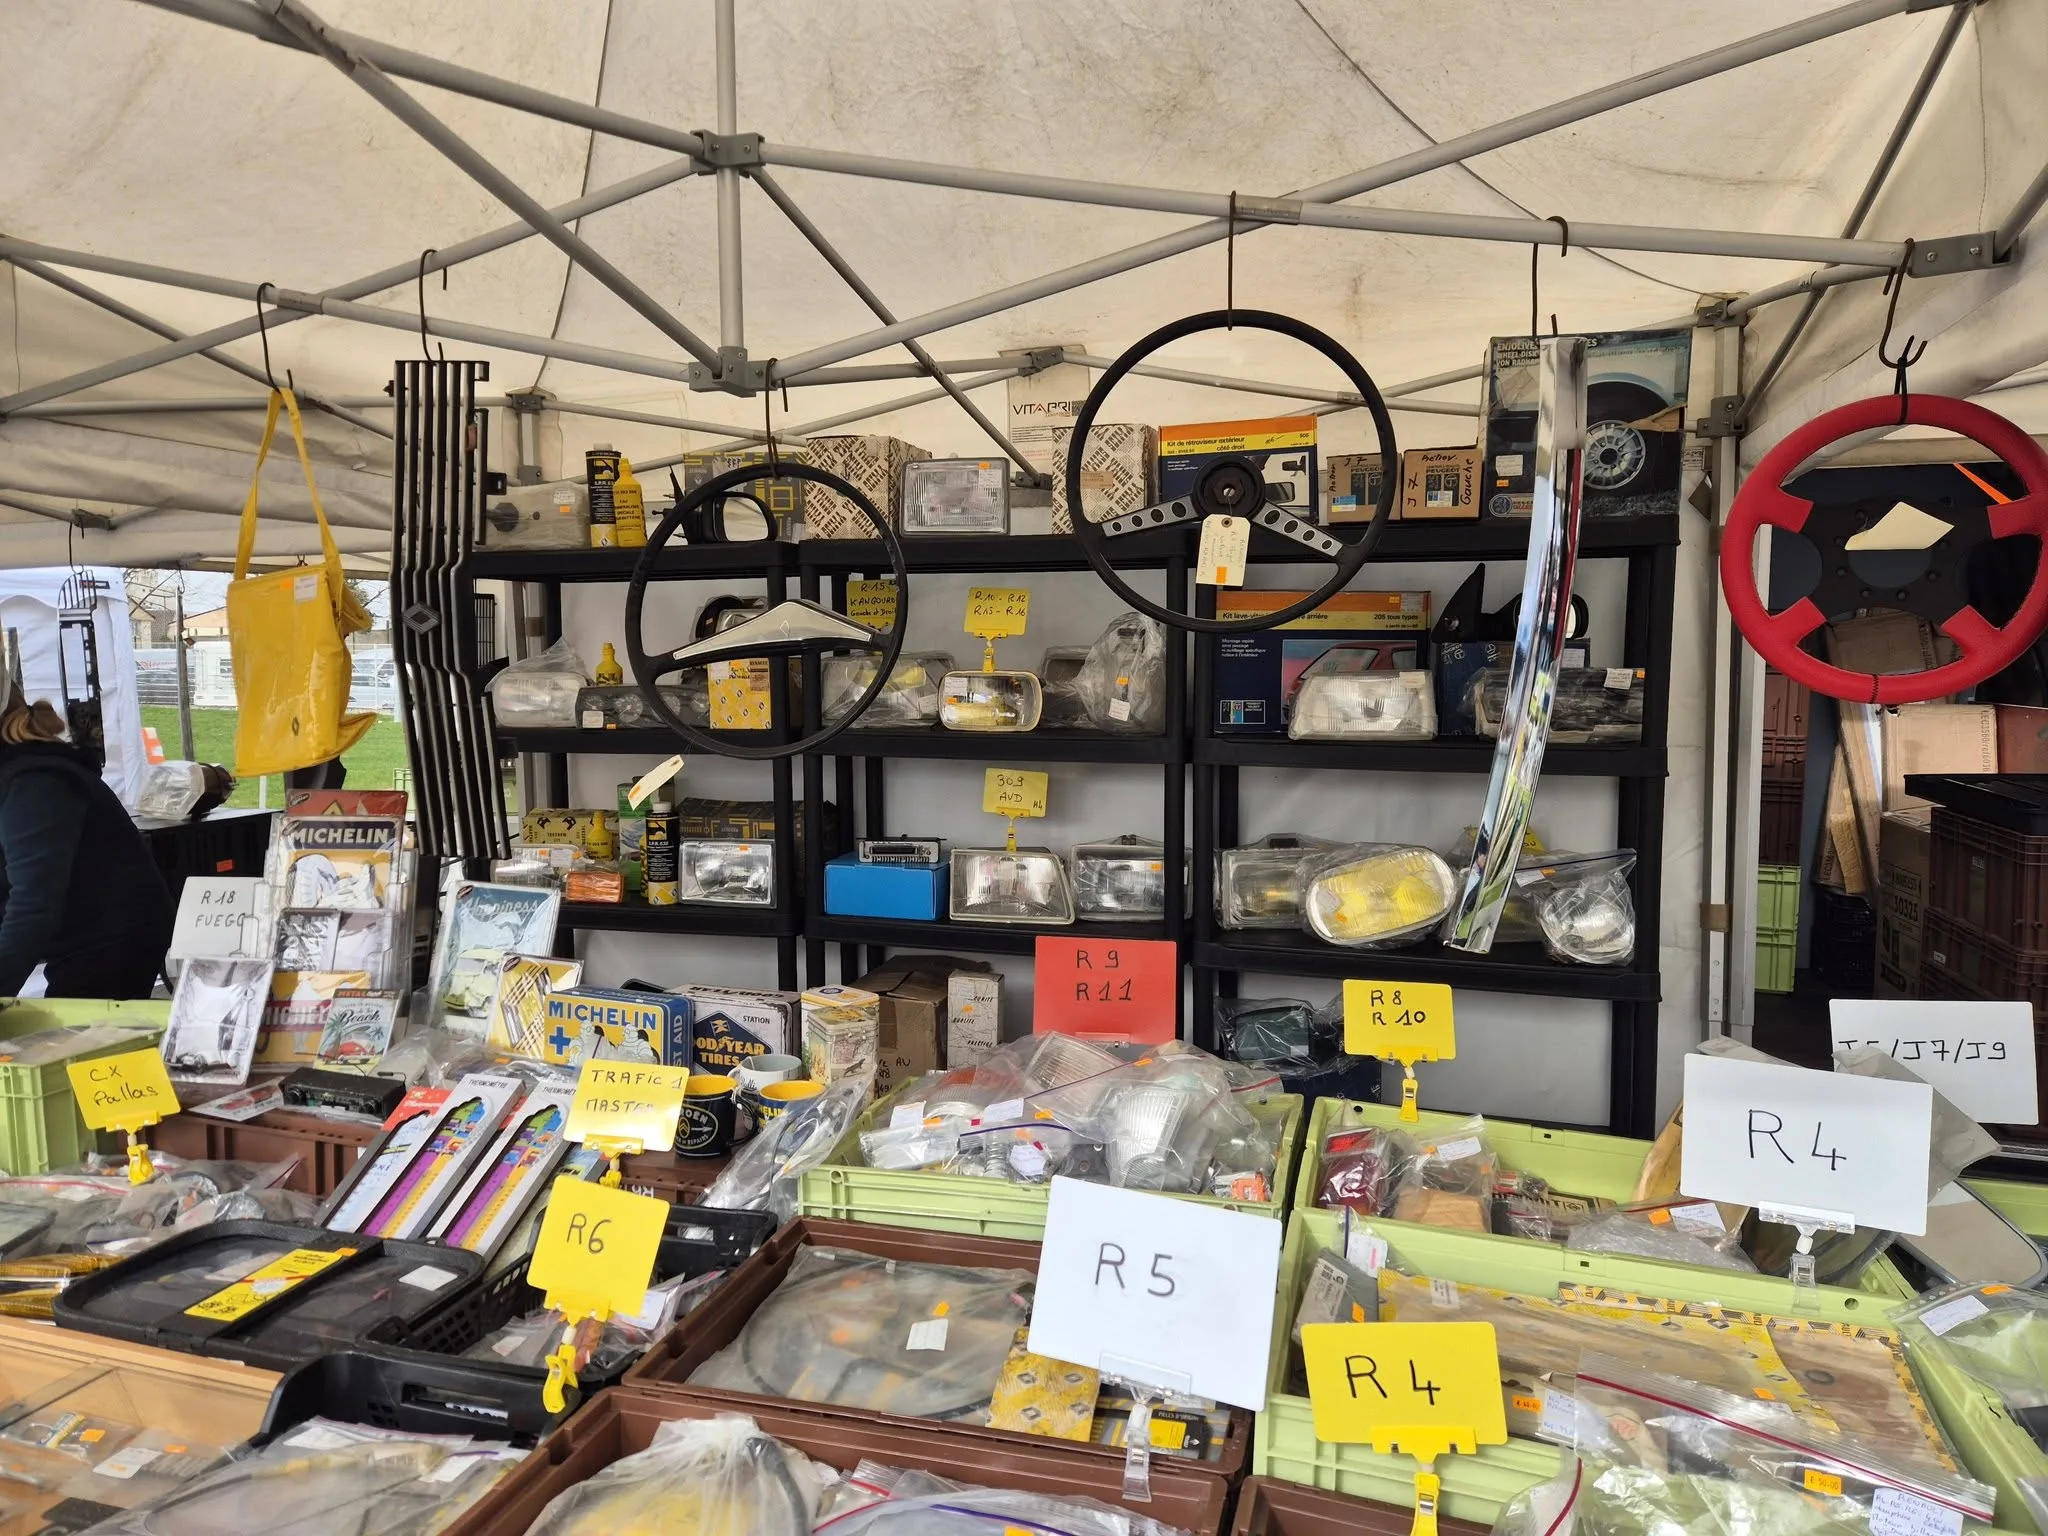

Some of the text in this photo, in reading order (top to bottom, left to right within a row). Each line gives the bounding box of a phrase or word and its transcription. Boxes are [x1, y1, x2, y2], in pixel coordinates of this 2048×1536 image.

[1497, 350, 1539, 359] WHEEL-DISK
[1498, 341, 1538, 351] ENJOLIVE
[1512, 357, 1540, 367] RADKAP
[1013, 401, 1071, 416] VITABRI
[1185, 437, 1218, 446] rétroviseur
[1460, 459, 1475, 506] Gauche
[850, 596, 896, 607] KANGOURO
[1401, 614, 1419, 622] types
[997, 774, 1025, 788] 309
[290, 827, 390, 845] MICHELIN
[262, 1005, 331, 1027] MICHEL
[338, 1007, 382, 1026] Beach
[548, 1000, 657, 1031] MICHELIN
[742, 1014, 771, 1026] STATION
[674, 1014, 683, 1044] AID
[694, 1036, 766, 1056] ODYEAR
[1838, 1037, 2007, 1064] /J7/J9
[699, 1051, 741, 1068] TIRES
[93, 1082, 160, 1107] Pallas
[585, 1098, 656, 1116] MASTER
[680, 1108, 709, 1125] ROEN
[565, 1212, 612, 1254] R6
